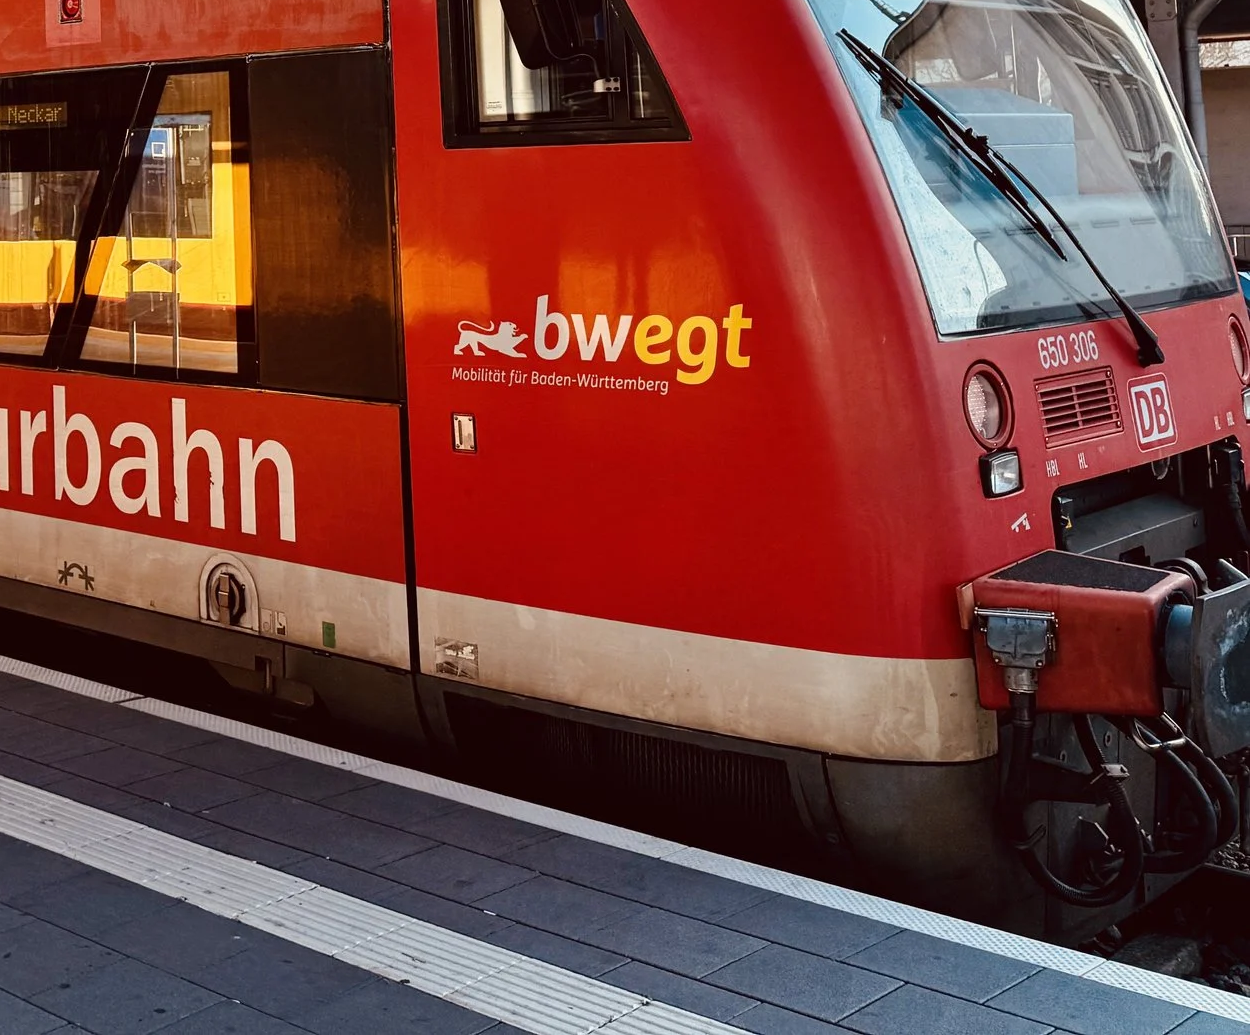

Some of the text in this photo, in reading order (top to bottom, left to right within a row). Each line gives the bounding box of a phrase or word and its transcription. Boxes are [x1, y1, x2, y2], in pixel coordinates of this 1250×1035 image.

[7, 104, 62, 124] Neckar
[533, 294, 753, 385] bwegt
[1037, 330, 1099, 369] 650 306
[451, 366, 669, 395] Mobilität für Baden-Württemberg
[1134, 386, 1170, 439] DB
[1045, 452, 1089, 478] HBL HL
